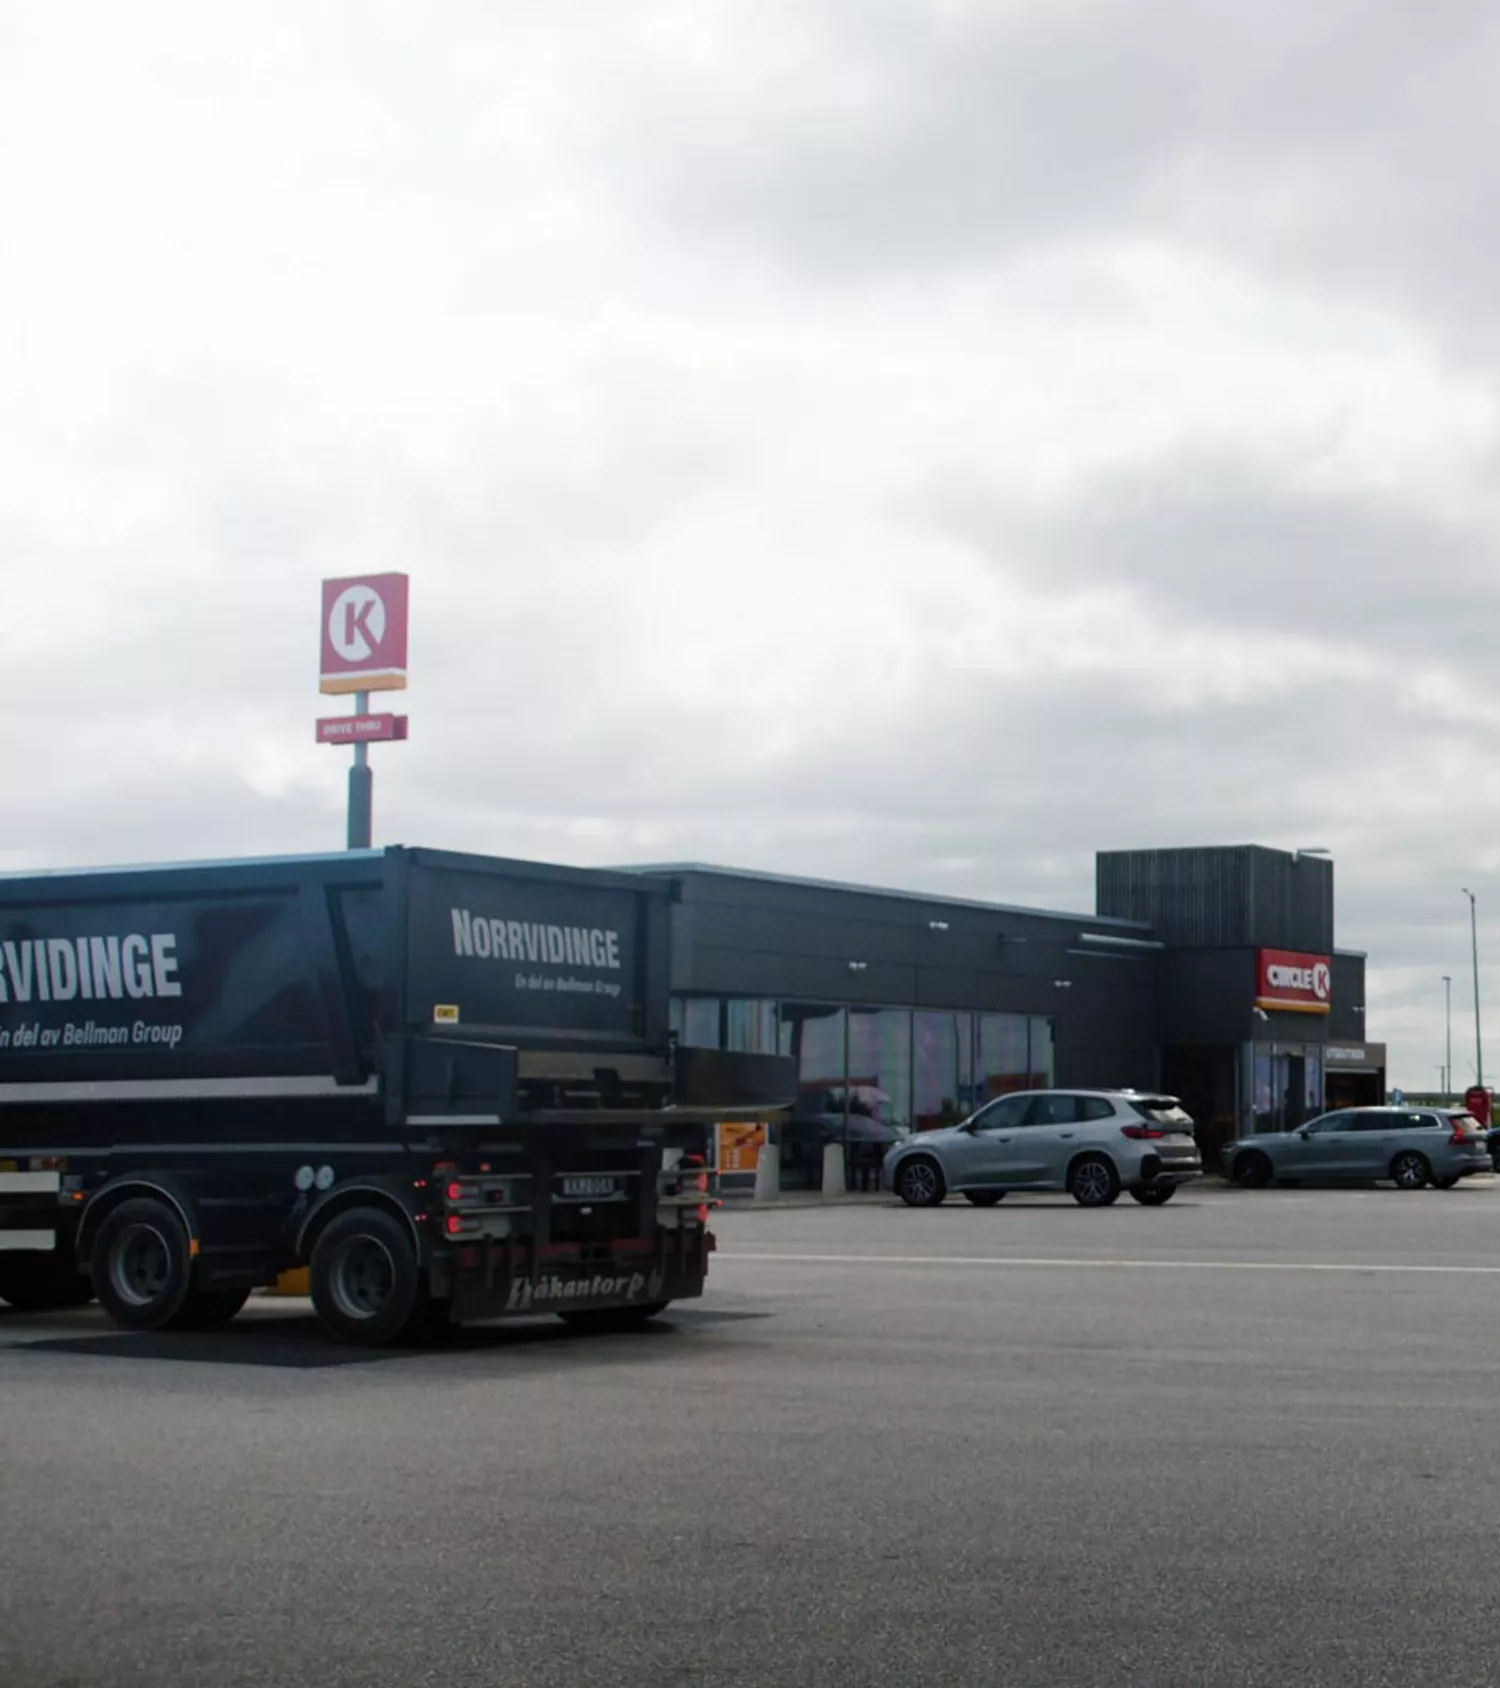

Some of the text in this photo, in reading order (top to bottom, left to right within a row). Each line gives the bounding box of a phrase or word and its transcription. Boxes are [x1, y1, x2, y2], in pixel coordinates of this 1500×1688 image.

[340, 594, 381, 657] K
[451, 907, 620, 969] NORRVIDINGE
[1267, 964, 1330, 996] CIRCLE K
[13, 1021, 40, 1048] del
[40, 1029, 60, 1047] av
[63, 1020, 128, 1046] Bellman
[132, 1020, 182, 1050] Group
